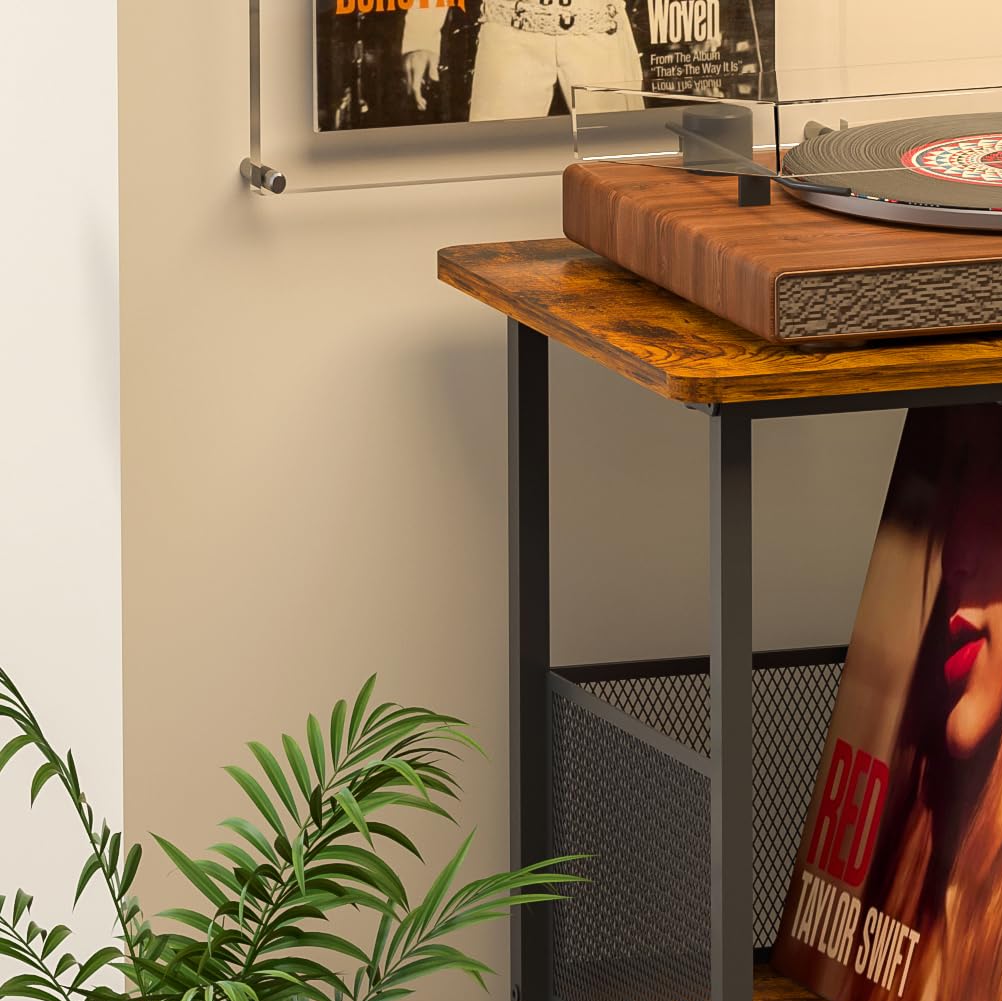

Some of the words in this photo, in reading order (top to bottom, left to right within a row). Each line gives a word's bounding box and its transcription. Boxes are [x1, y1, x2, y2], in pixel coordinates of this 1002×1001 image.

[647, 0, 721, 44] Woven
[650, 53, 674, 66] From
[675, 52, 691, 63] The
[693, 51, 721, 63] Album
[685, 64, 701, 76] The
[701, 63, 721, 77] Way
[723, 63, 730, 73] It
[806, 736, 890, 889] RED
[791, 870, 862, 967] TAYLOR
[854, 906, 921, 998] SWIFT
